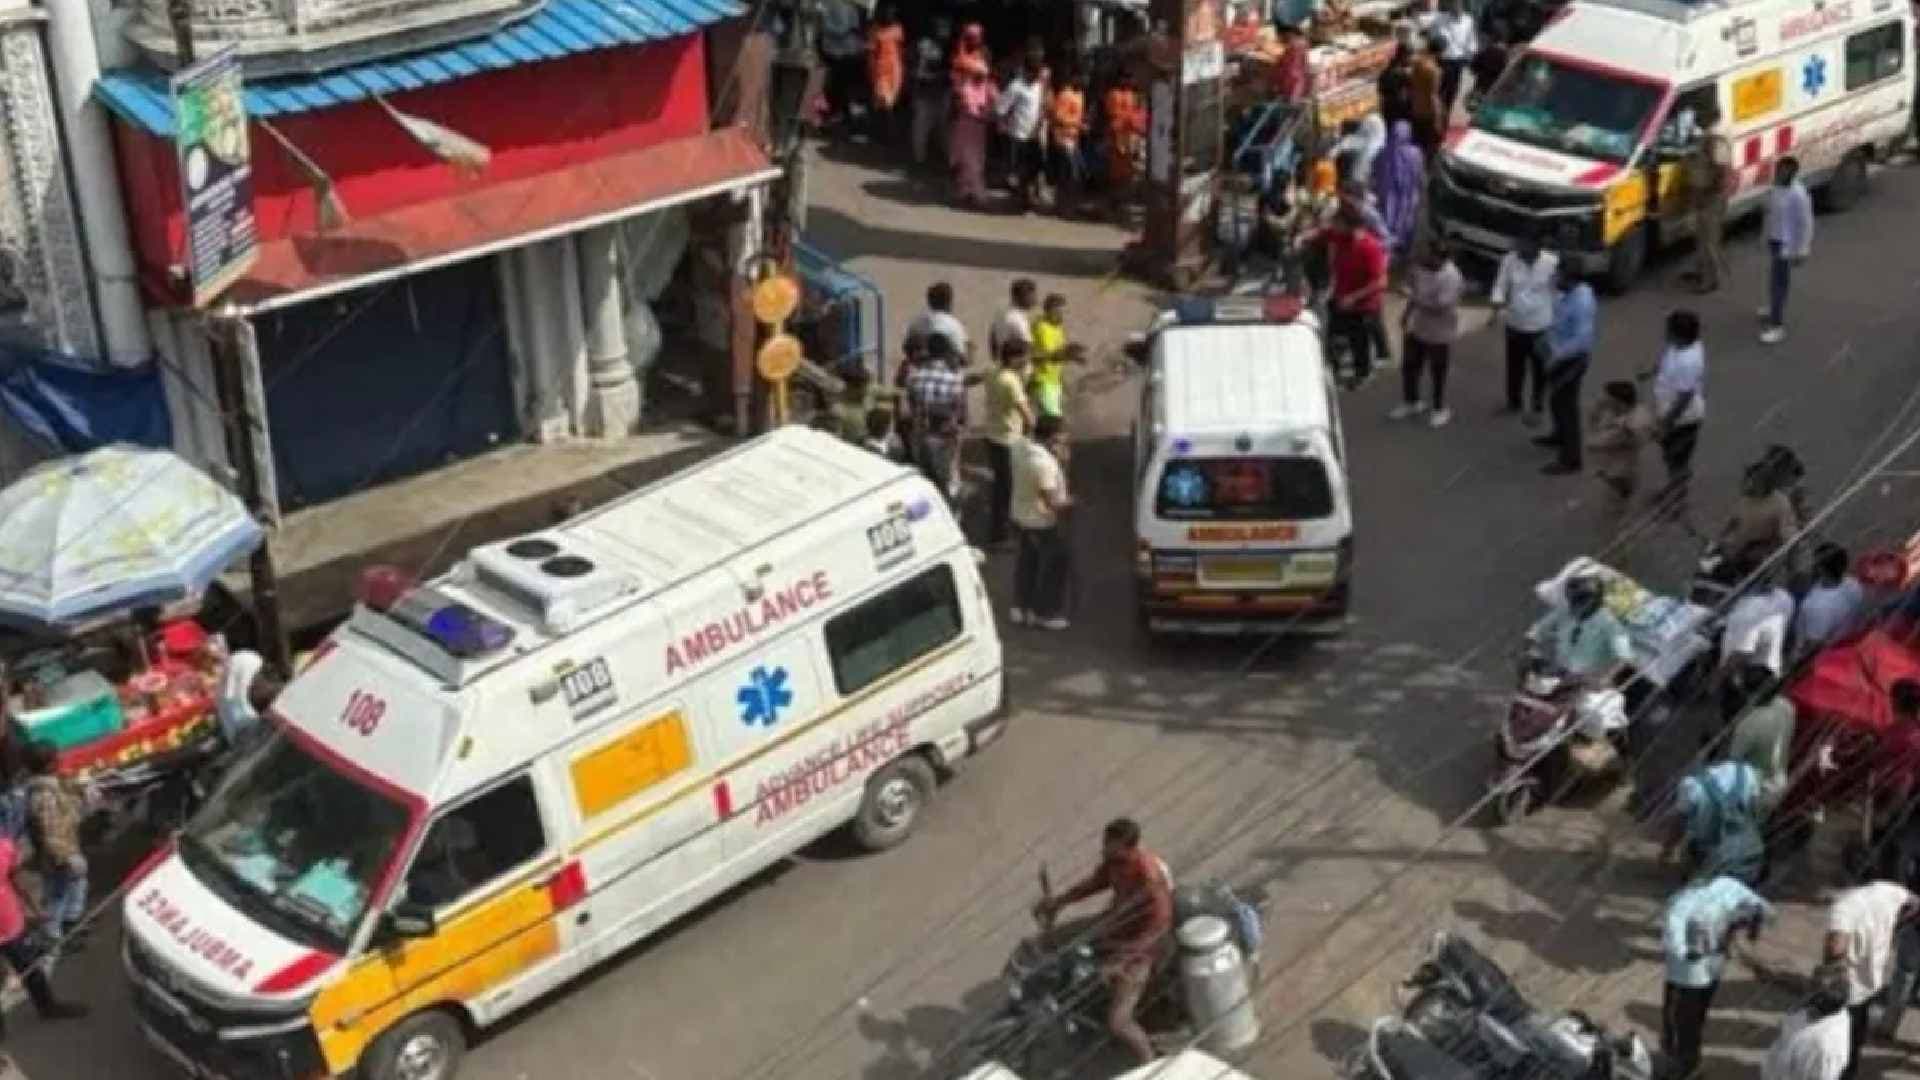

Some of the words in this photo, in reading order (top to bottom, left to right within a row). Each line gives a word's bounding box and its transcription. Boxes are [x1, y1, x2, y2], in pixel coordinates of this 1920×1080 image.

[666, 570, 832, 675] AMBULANCE
[341, 687, 386, 736] 108
[756, 727, 910, 826] AMBULANCE
